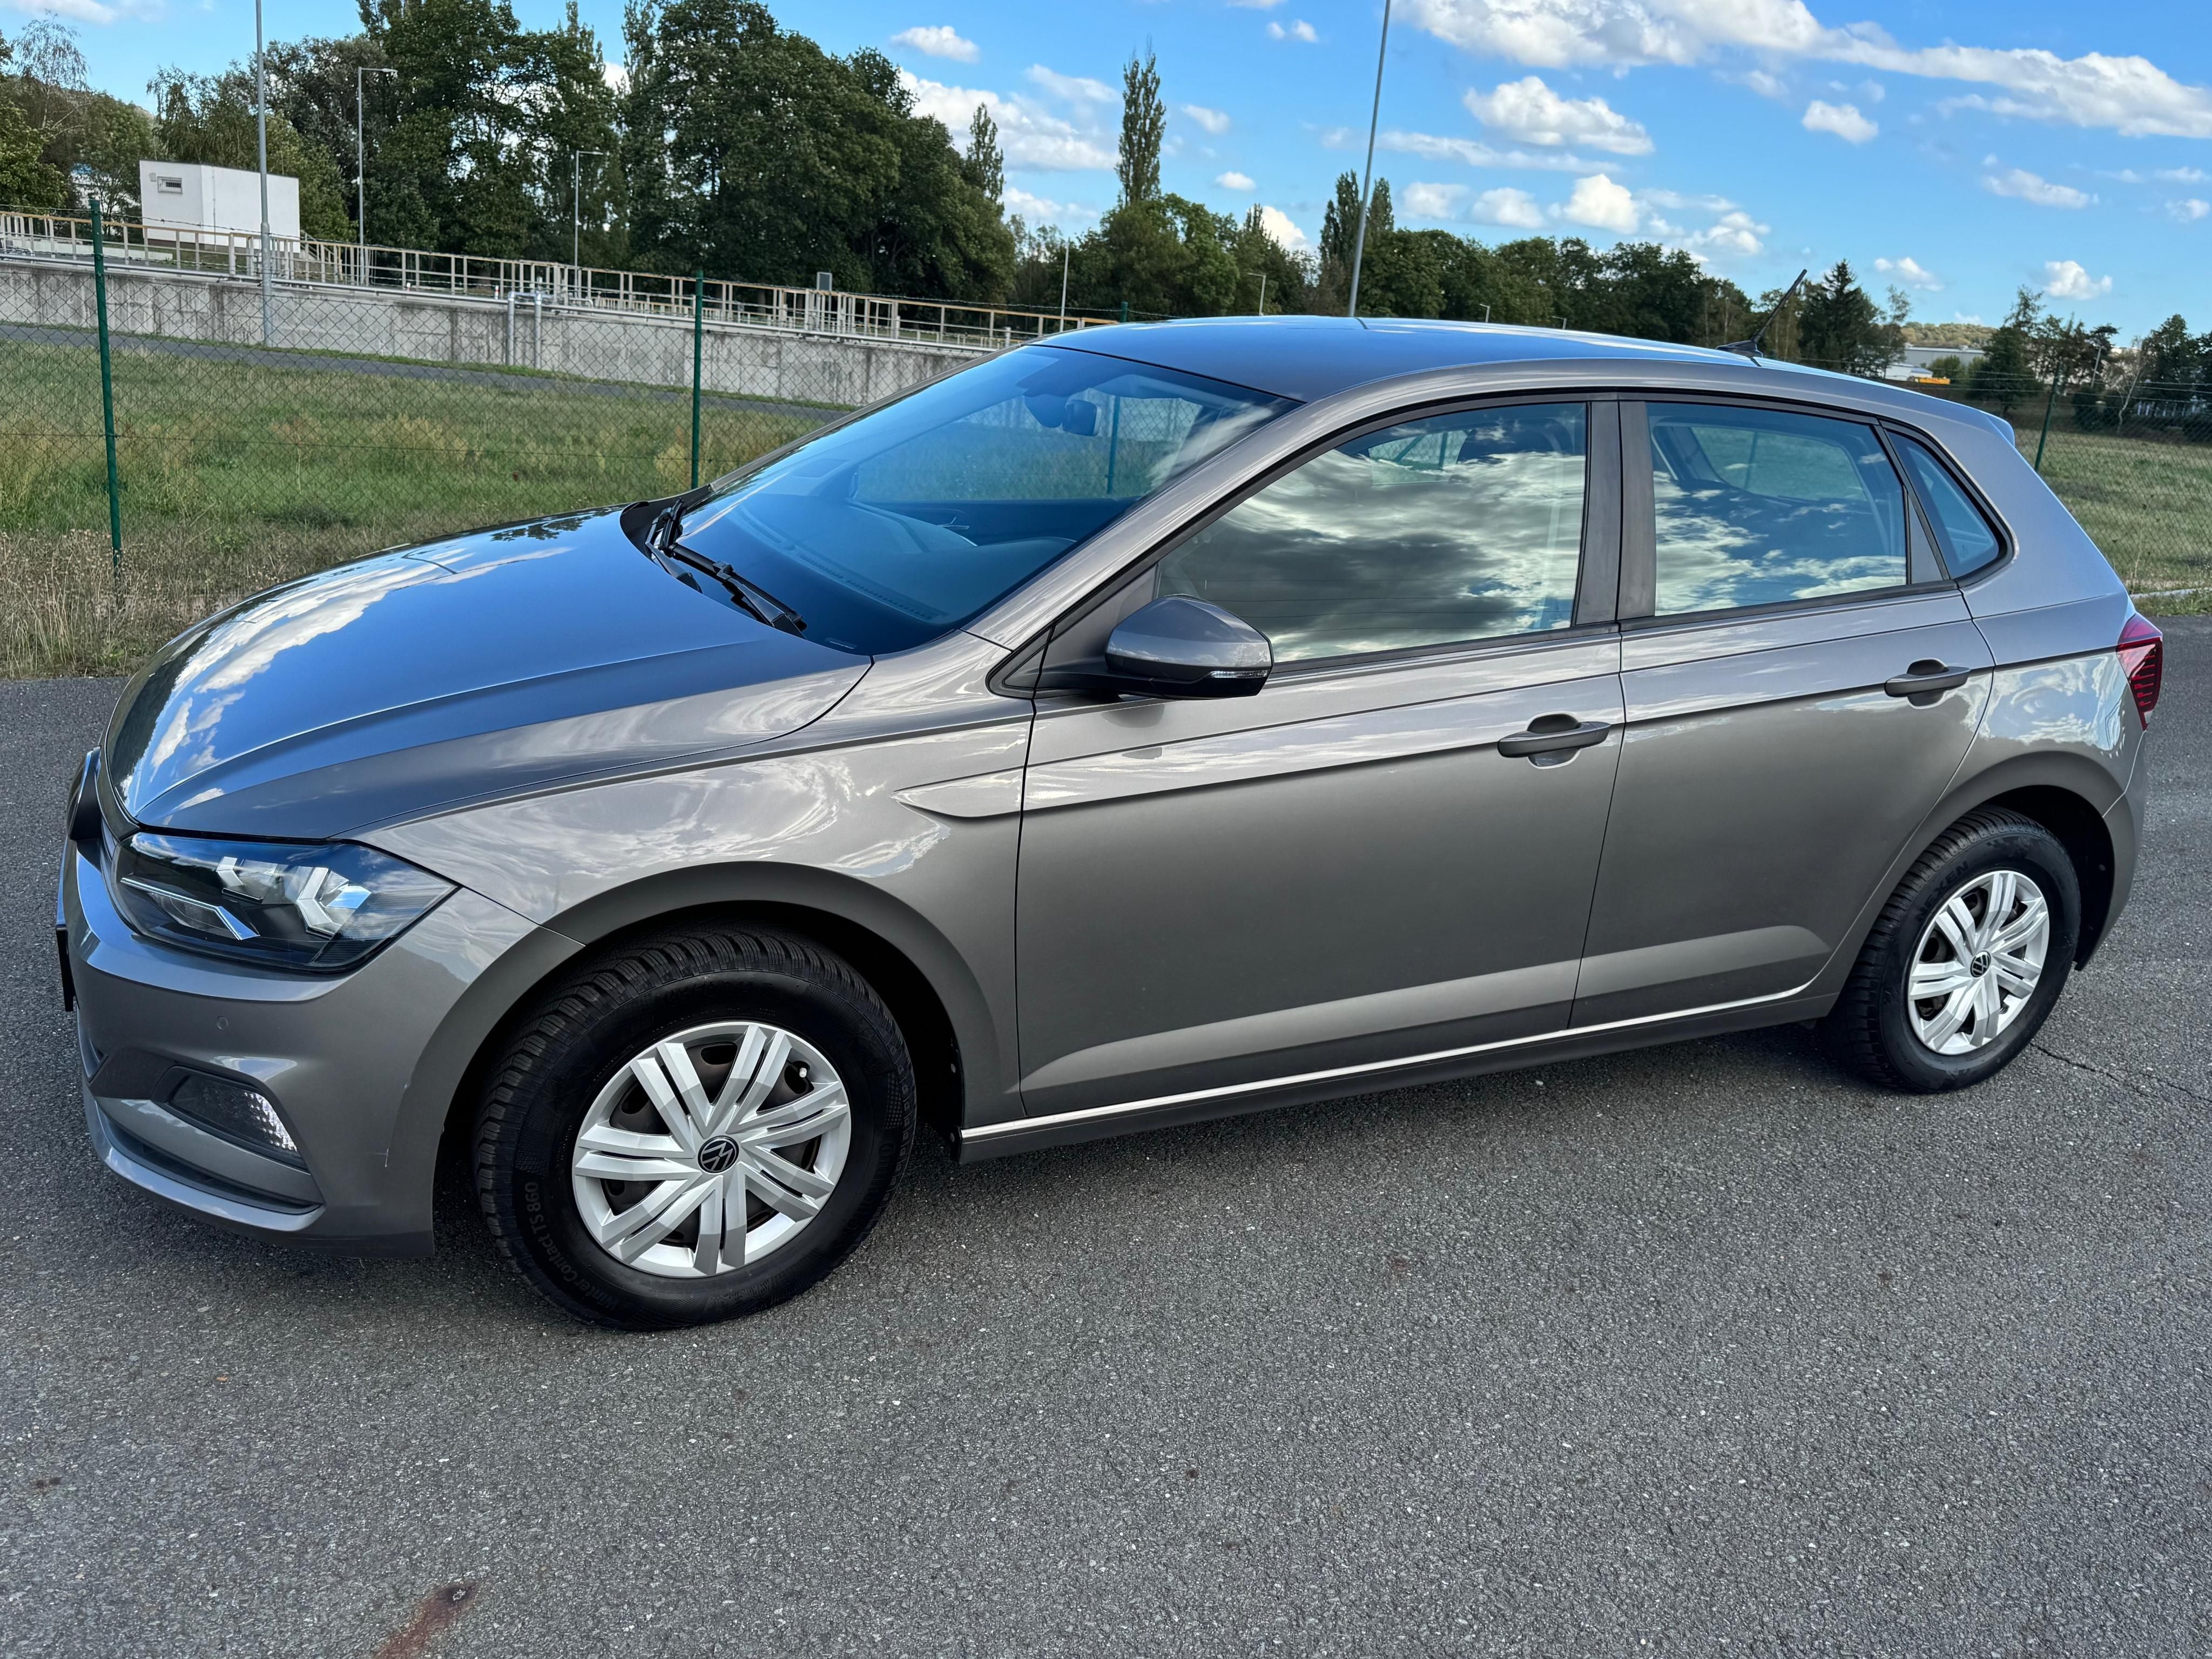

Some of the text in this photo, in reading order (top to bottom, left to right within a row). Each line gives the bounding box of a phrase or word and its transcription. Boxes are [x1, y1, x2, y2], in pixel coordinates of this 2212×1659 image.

[1915, 860, 1968, 922] NEXEN
[525, 1182, 541, 1212] 860
[529, 1214, 547, 1235] TS
